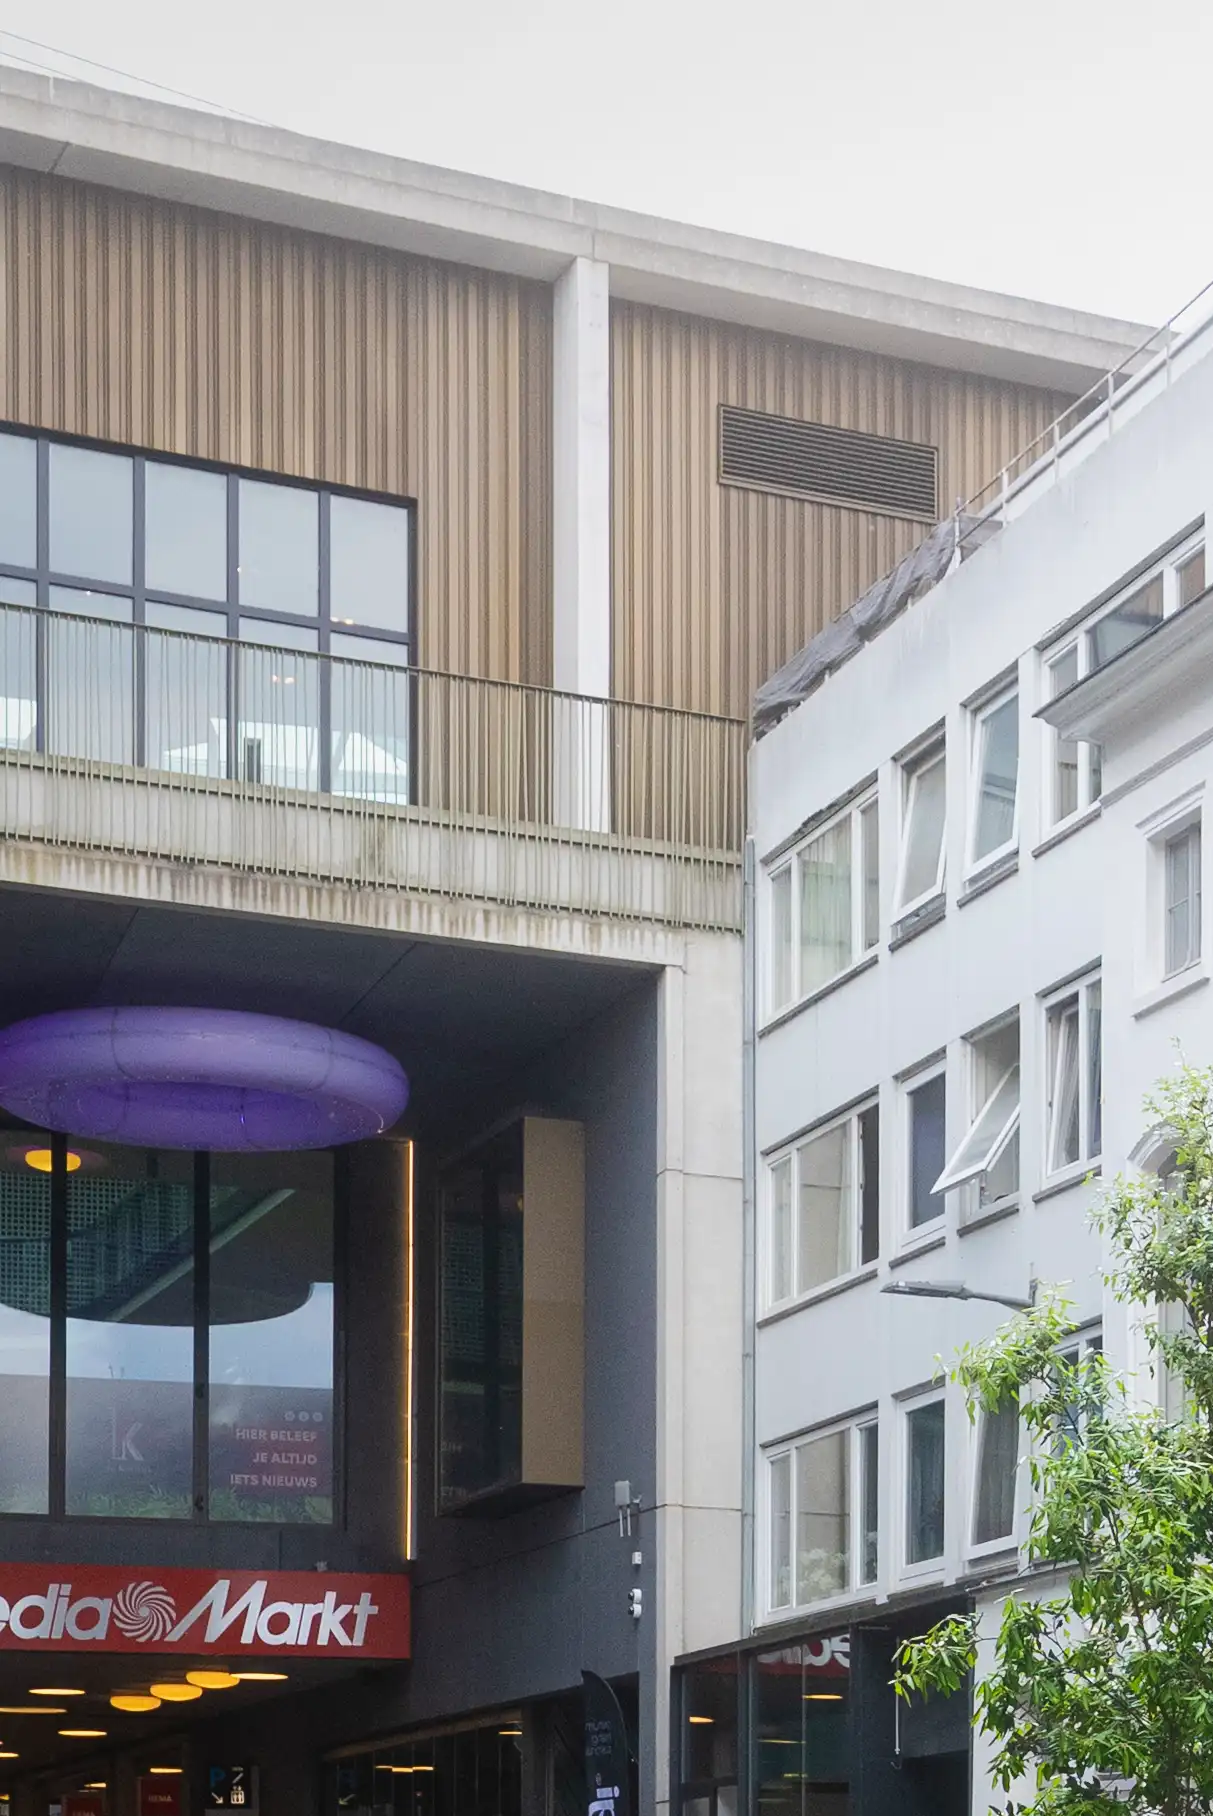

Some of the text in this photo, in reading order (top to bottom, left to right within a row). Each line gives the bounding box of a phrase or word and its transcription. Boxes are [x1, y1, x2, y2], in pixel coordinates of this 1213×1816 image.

[235, 1428, 318, 1442] HIER BELEEF
[252, 1452, 318, 1465] JE ALTIJD
[230, 1474, 318, 1488] IETS NIEUWS
[0, 1579, 379, 1647] dia Markt
